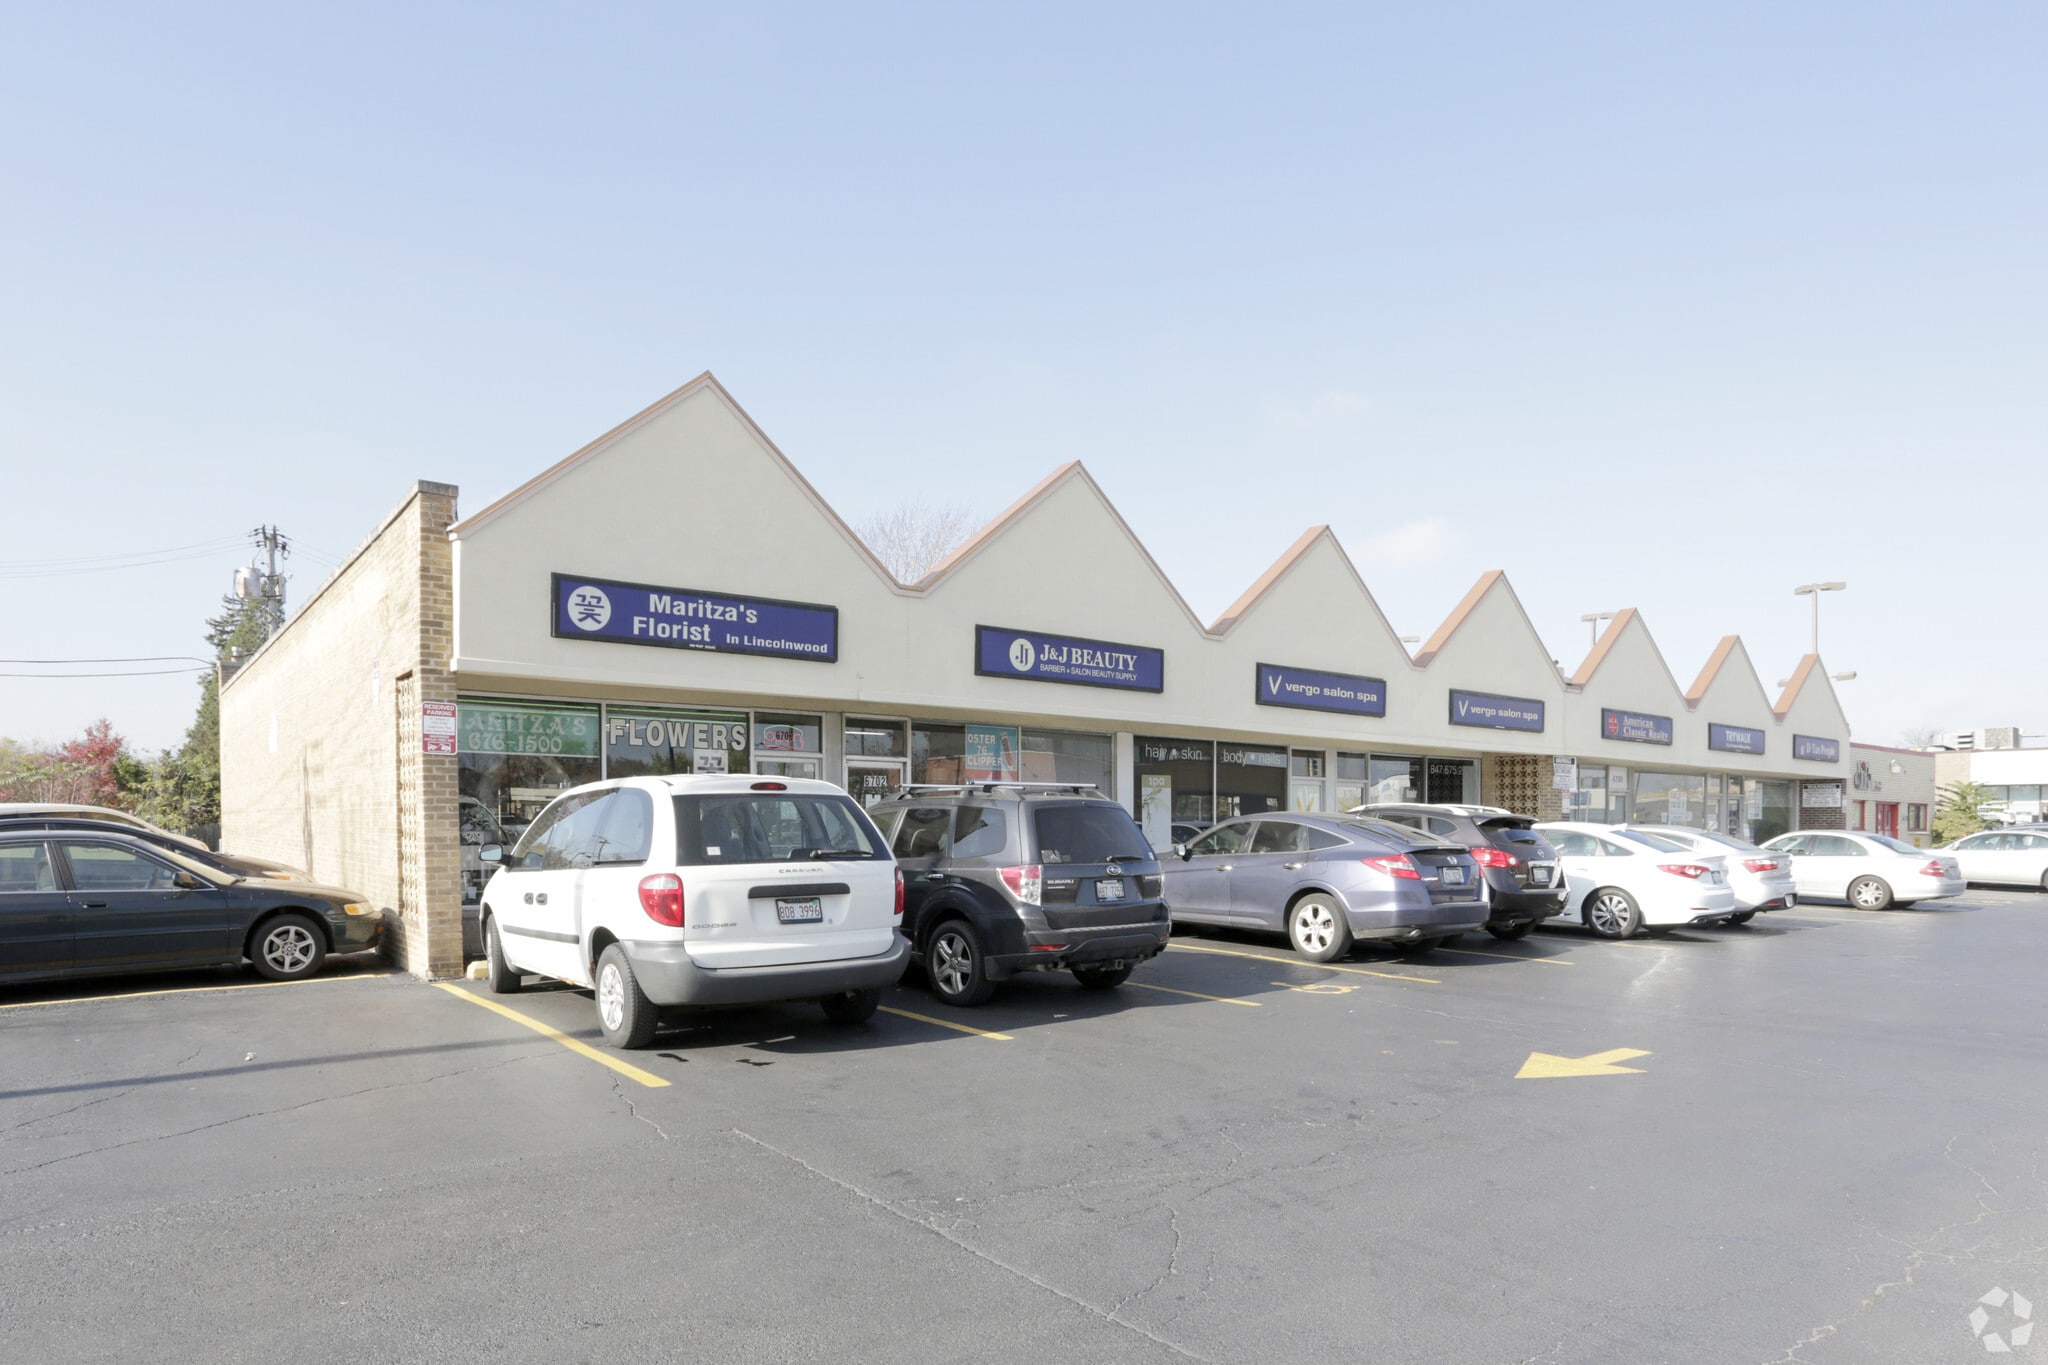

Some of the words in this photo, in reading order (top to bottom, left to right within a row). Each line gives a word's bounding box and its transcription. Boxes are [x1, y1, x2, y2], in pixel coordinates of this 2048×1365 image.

[649, 593, 758, 624] Maritza's
[633, 615, 711, 642] Florist
[726, 633, 739, 645] In
[743, 635, 828, 654] Lincolnwood
[1040, 644, 1068, 664] J&J
[1071, 648, 1137, 671] BEAUTY
[1040, 664, 1065, 674] BARBER
[1071, 667, 1091, 676] SALON
[1092, 669, 1115, 679] BEAUTY
[1115, 671, 1137, 681] SUPPLY
[1268, 674, 1282, 696] V
[1285, 682, 1320, 697] vergo
[1323, 686, 1354, 699] salon
[1357, 692, 1377, 703] spa
[1459, 700, 1469, 717] V
[1470, 706, 1496, 718] vergo
[1498, 708, 1521, 719] salon
[1523, 711, 1538, 721] spa
[1623, 715, 1654, 727] American
[609, 717, 746, 751] FLOWERS
[967, 733, 996, 745] OSTER
[1623, 725, 1648, 736] Classic
[1648, 729, 1669, 741] Realty
[468, 732, 562, 753] 676-1500
[976, 745, 988, 754] 76
[1145, 743, 1167, 758] hair
[1181, 746, 1203, 760] skin
[1223, 750, 1247, 767] body
[1259, 753, 1280, 765] nails
[967, 755, 1003, 767] CLIPPER
[1431, 764, 1464, 775] 847.675.2
[864, 776, 886, 787] 6702
[799, 904, 820, 917] 3996
